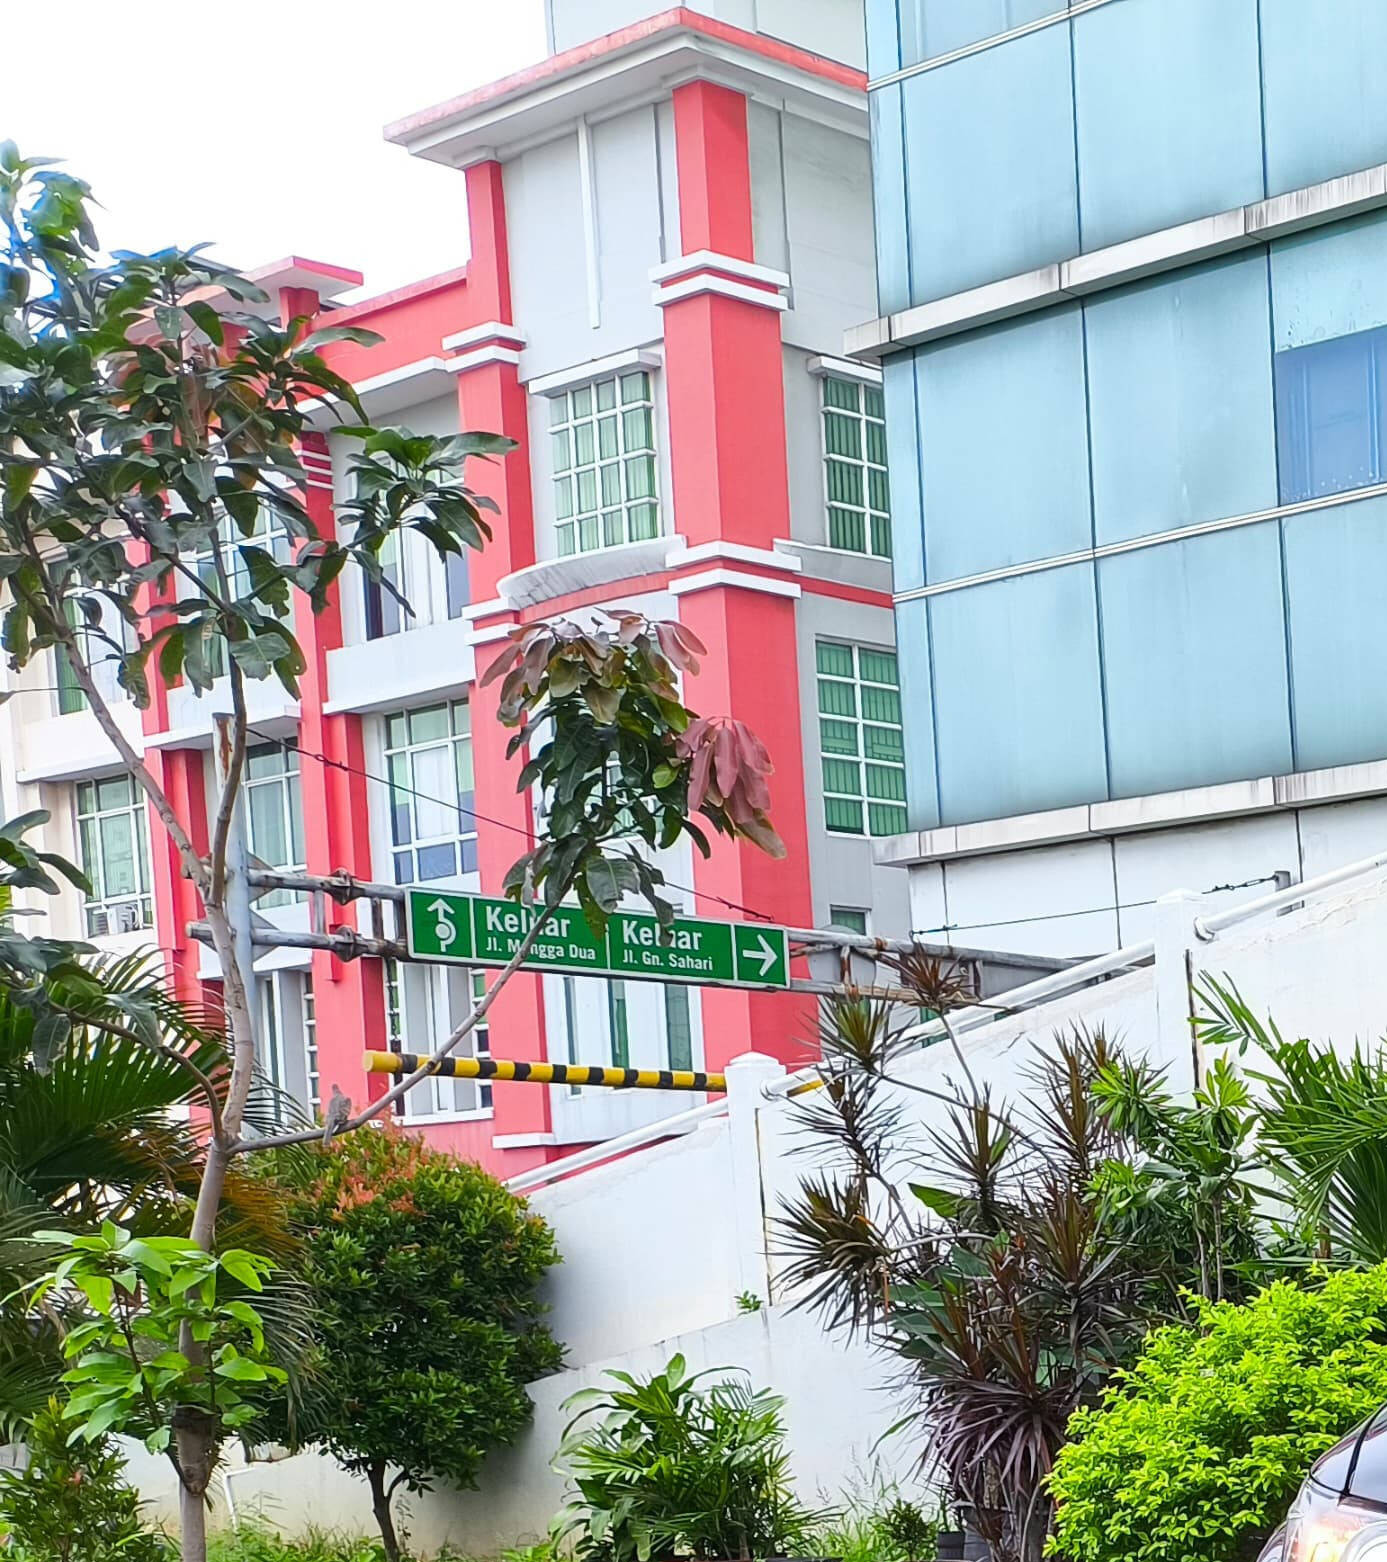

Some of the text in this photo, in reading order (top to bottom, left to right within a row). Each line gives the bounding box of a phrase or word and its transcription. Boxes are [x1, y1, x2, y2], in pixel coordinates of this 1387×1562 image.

[486, 937, 596, 960] Jl. Mngga Dua
[623, 949, 713, 971] Jl. Gn. Sahari
